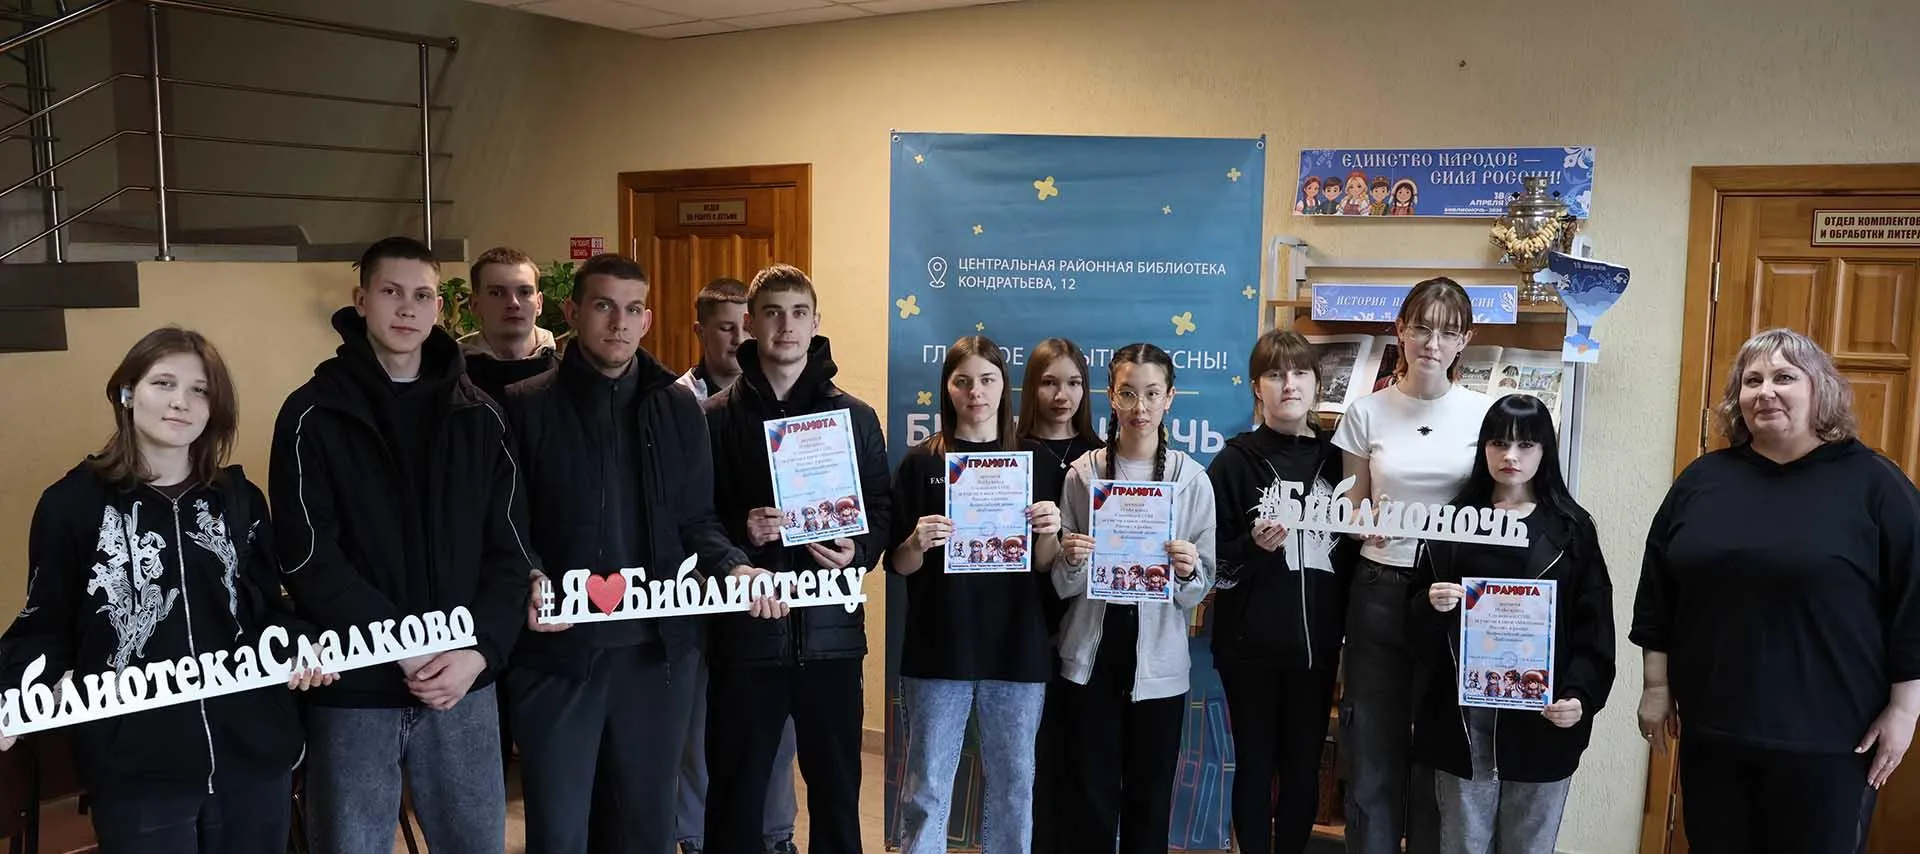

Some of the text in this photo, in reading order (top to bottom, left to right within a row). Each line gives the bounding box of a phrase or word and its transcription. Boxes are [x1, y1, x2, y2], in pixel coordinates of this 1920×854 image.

[1342, 153, 1432, 168] ЕДИНСТВО
[1438, 152, 1518, 168] НАРОДОВ
[1430, 170, 1476, 185] СИЛА
[1824, 216, 1855, 227] ОТДЕЛ
[1820, 229, 1826, 238] И
[1829, 229, 1884, 239] ОБРАБОТКИ
[958, 258, 1226, 275] ЦЕНТРАЛЬНАЯ РАЙОННАЯ БИБЛИОТЕКА
[958, 275, 1076, 291] КОНДРАТЬЕВА, 12
[1336, 296, 1386, 306] ИСТОРИЯ
[787, 417, 837, 434] ГРАМОТА
[968, 458, 1018, 468] ГРАМОТА
[1113, 486, 1162, 497] ГРАМОТА
[1257, 475, 1528, 545] #Библионочь
[1486, 584, 1540, 596] ГРАМОТА
